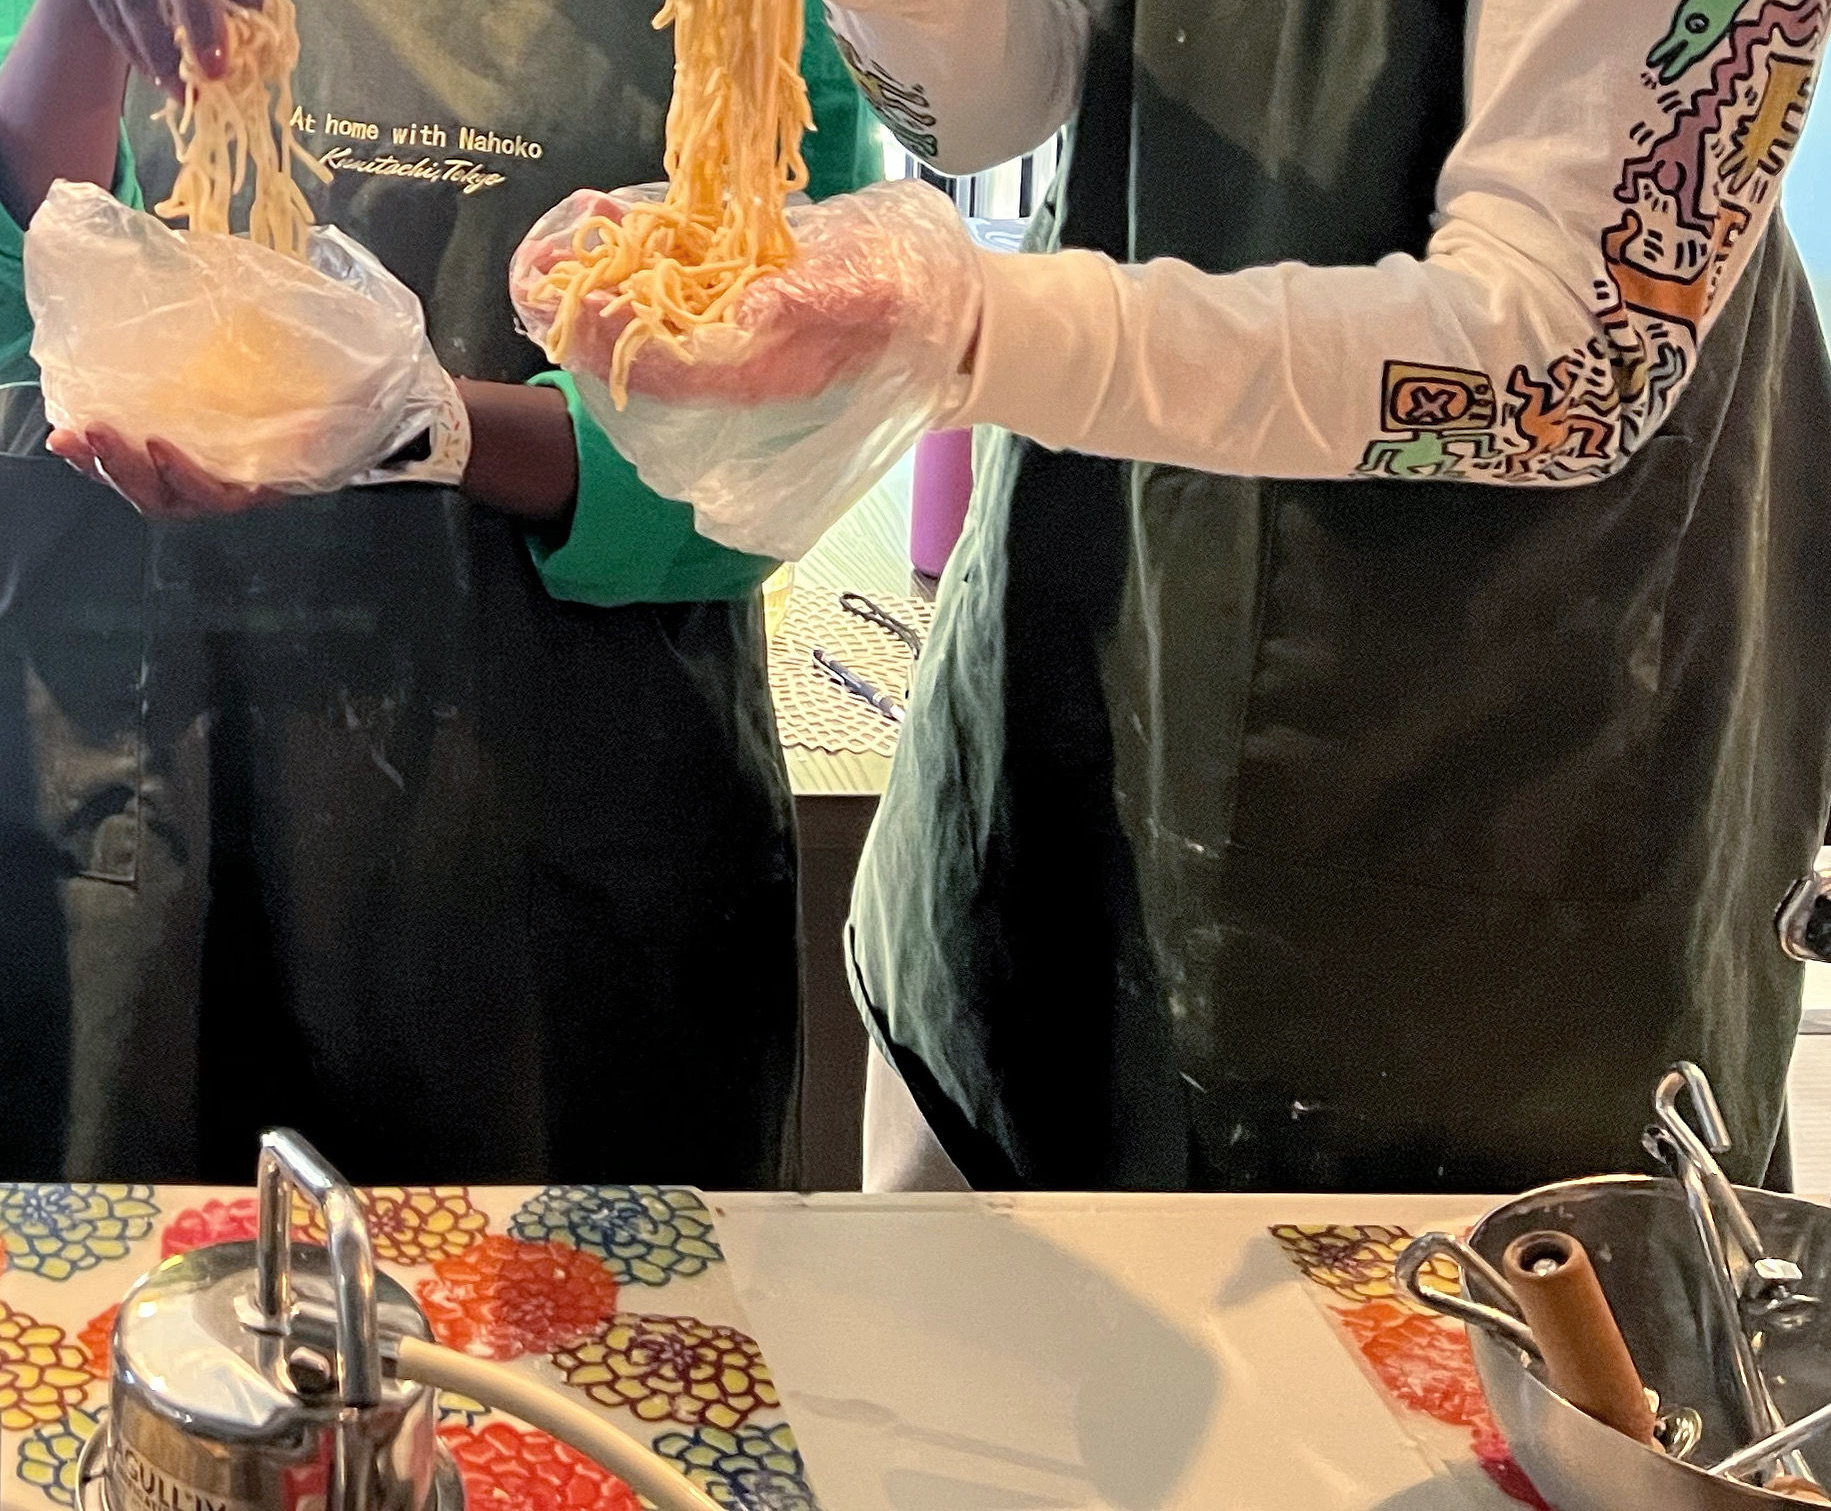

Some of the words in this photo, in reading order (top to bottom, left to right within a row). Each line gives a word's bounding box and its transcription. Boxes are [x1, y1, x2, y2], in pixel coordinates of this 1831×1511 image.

[289, 105, 316, 133] At
[324, 112, 380, 140] home
[391, 123, 447, 148] with
[458, 126, 544, 160] Nahoko
